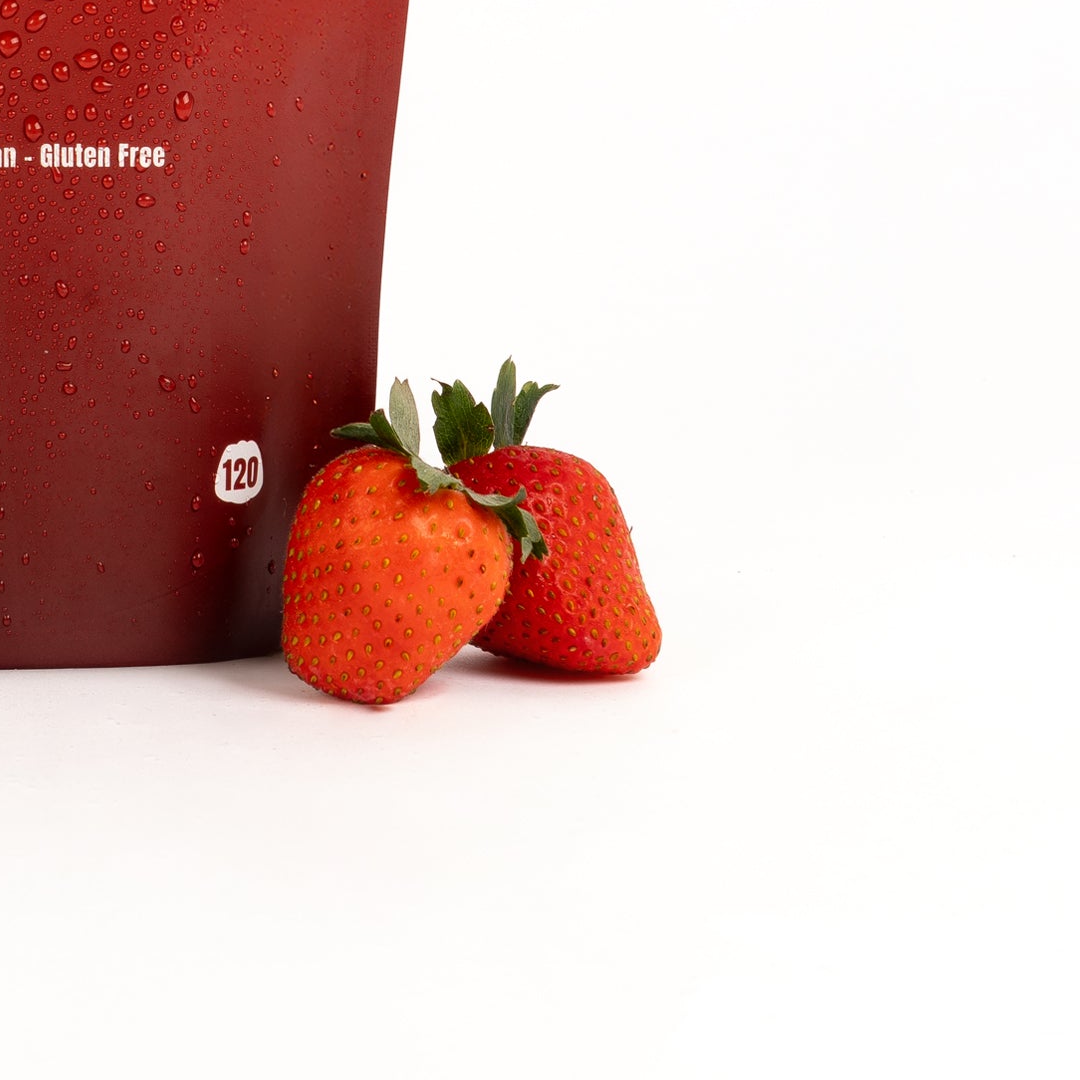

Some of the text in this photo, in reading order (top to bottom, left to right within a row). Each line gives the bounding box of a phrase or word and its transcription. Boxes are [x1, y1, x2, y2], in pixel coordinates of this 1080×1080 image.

[40, 143, 111, 168] Gluten
[118, 143, 166, 168] Free
[222, 456, 259, 491] 120
